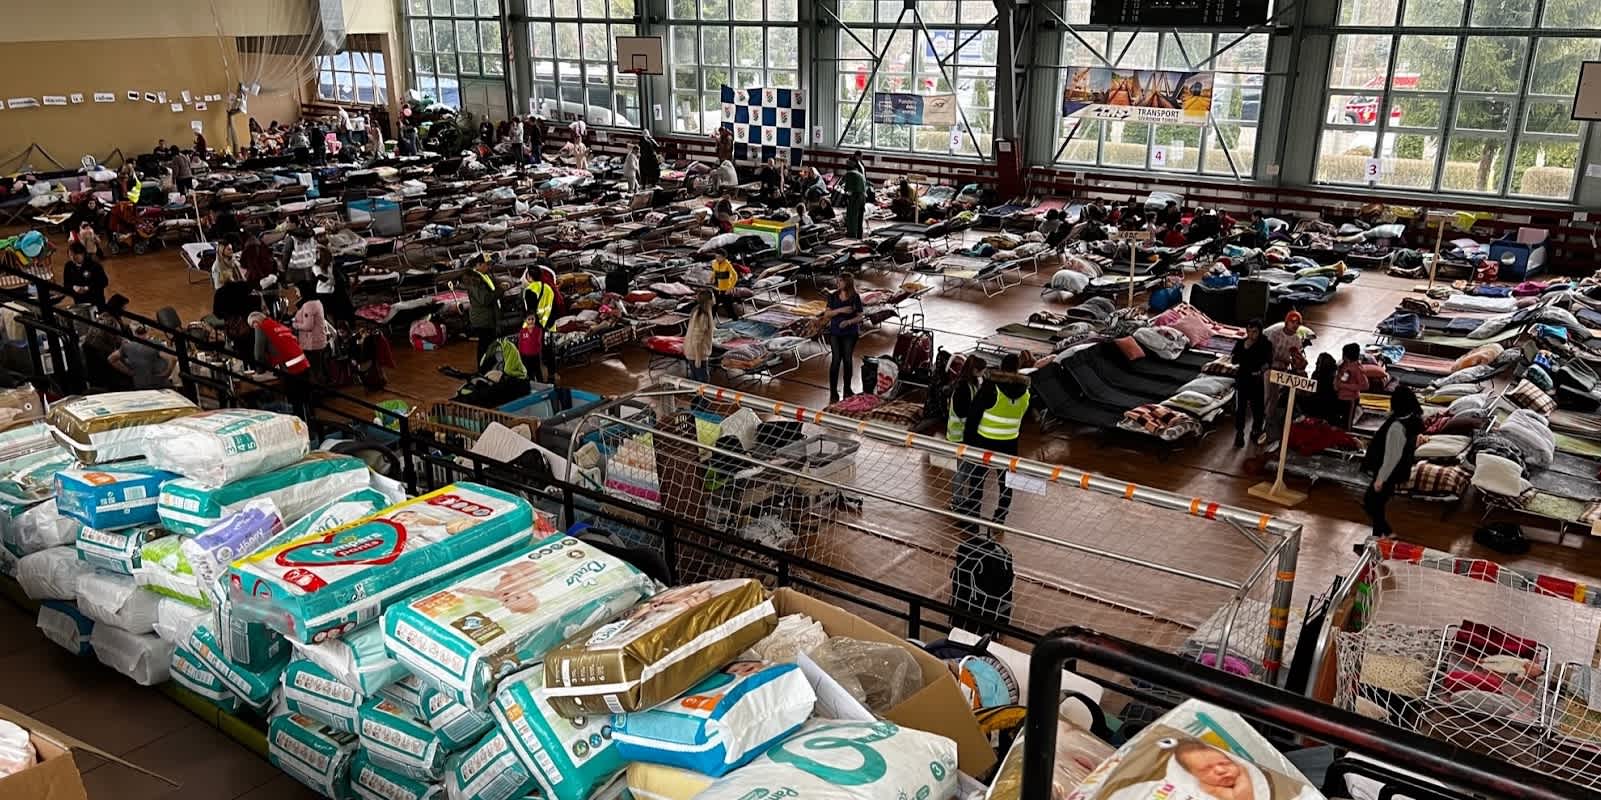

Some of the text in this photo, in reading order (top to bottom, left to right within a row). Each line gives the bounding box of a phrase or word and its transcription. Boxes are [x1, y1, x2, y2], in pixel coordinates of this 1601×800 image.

[1138, 108, 1179, 118] TRANSPORT
[815, 129, 821, 139] 6
[953, 135, 959, 145] 5
[1155, 151, 1162, 161] 4
[1369, 164, 1377, 175] 3
[312, 532, 383, 557] Pampers
